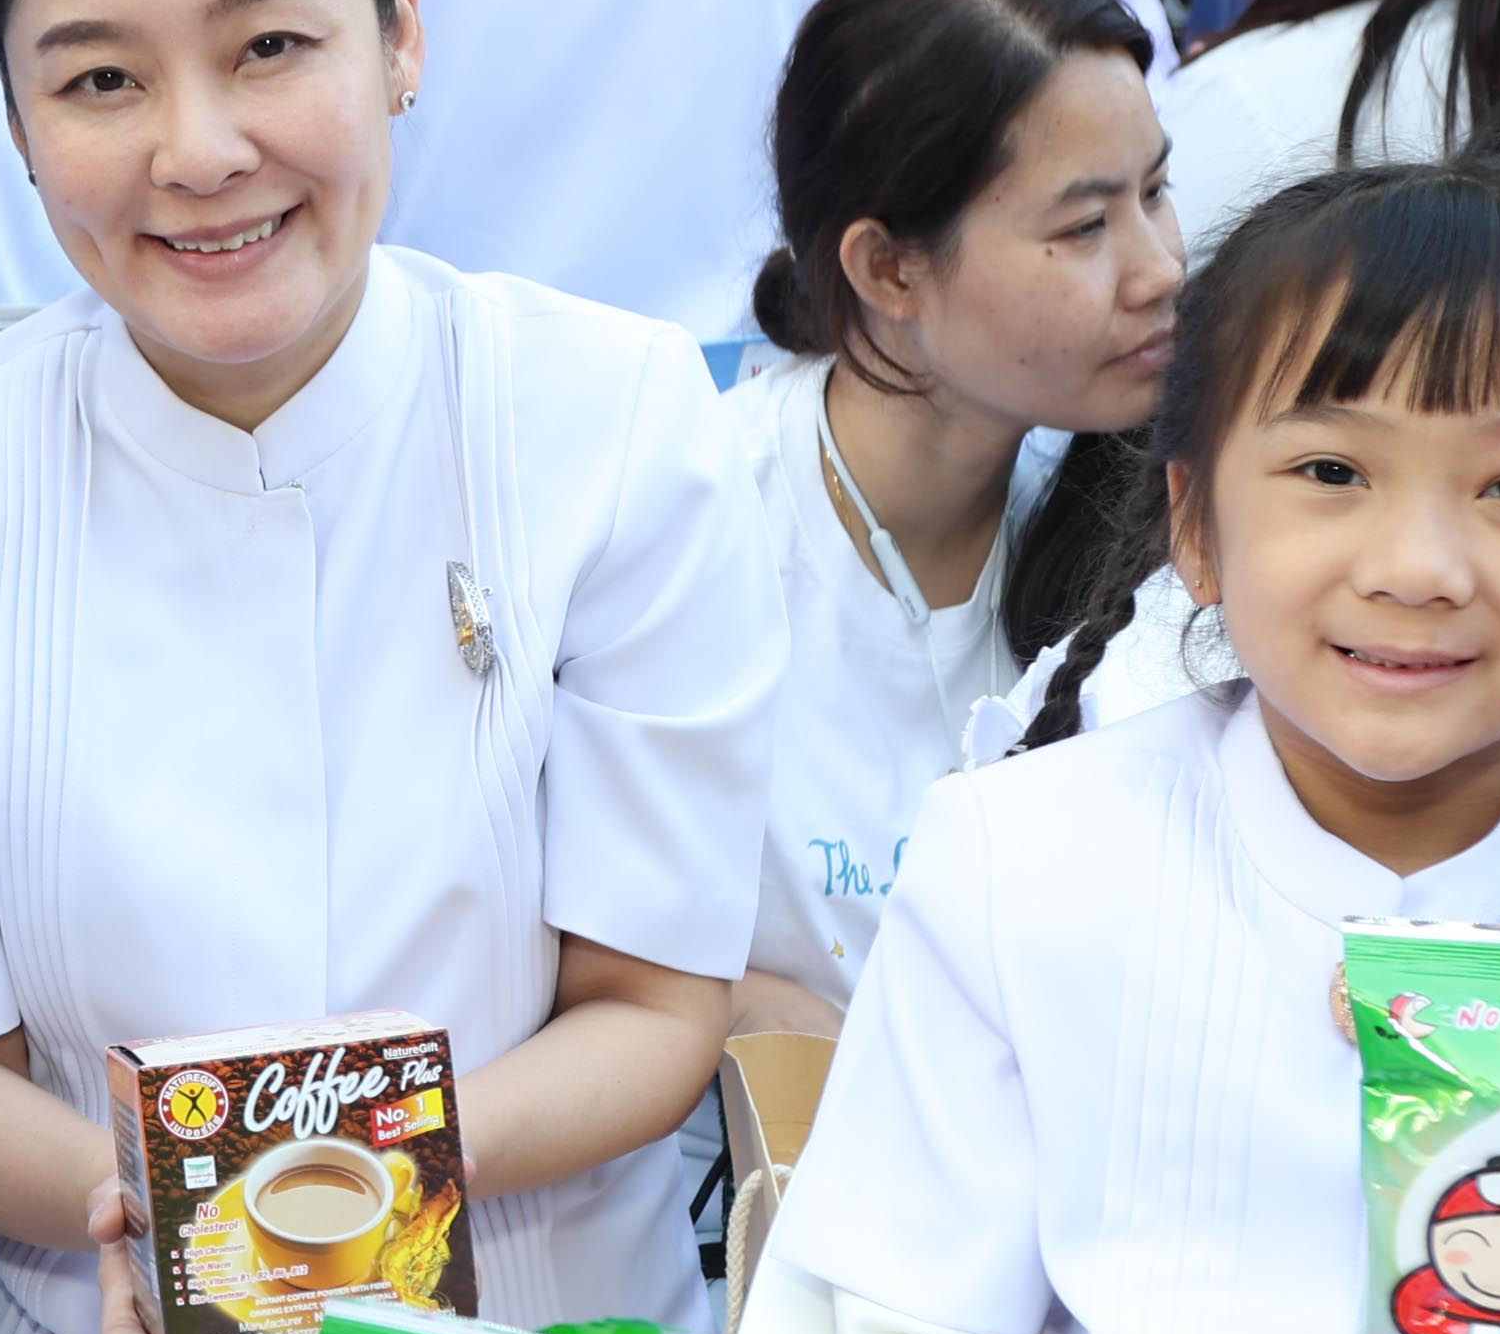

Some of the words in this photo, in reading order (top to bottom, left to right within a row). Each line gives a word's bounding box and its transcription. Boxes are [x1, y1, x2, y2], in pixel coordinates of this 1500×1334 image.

[383, 1042, 439, 1060] NatureGift
[164, 1072, 221, 1100] NATUREGIFT
[243, 1047, 390, 1140] Coffee
[400, 1057, 444, 1091] Plus
[375, 1106, 410, 1127] No.
[415, 1096, 426, 1112] 1
[377, 1125, 401, 1141] Best
[403, 1113, 441, 1133] Selling
[195, 1202, 220, 1221] No
[179, 1219, 239, 1238] Cholesterol
[184, 1248, 206, 1260] High
[185, 1263, 206, 1274] High
[187, 1278, 208, 1291] High
